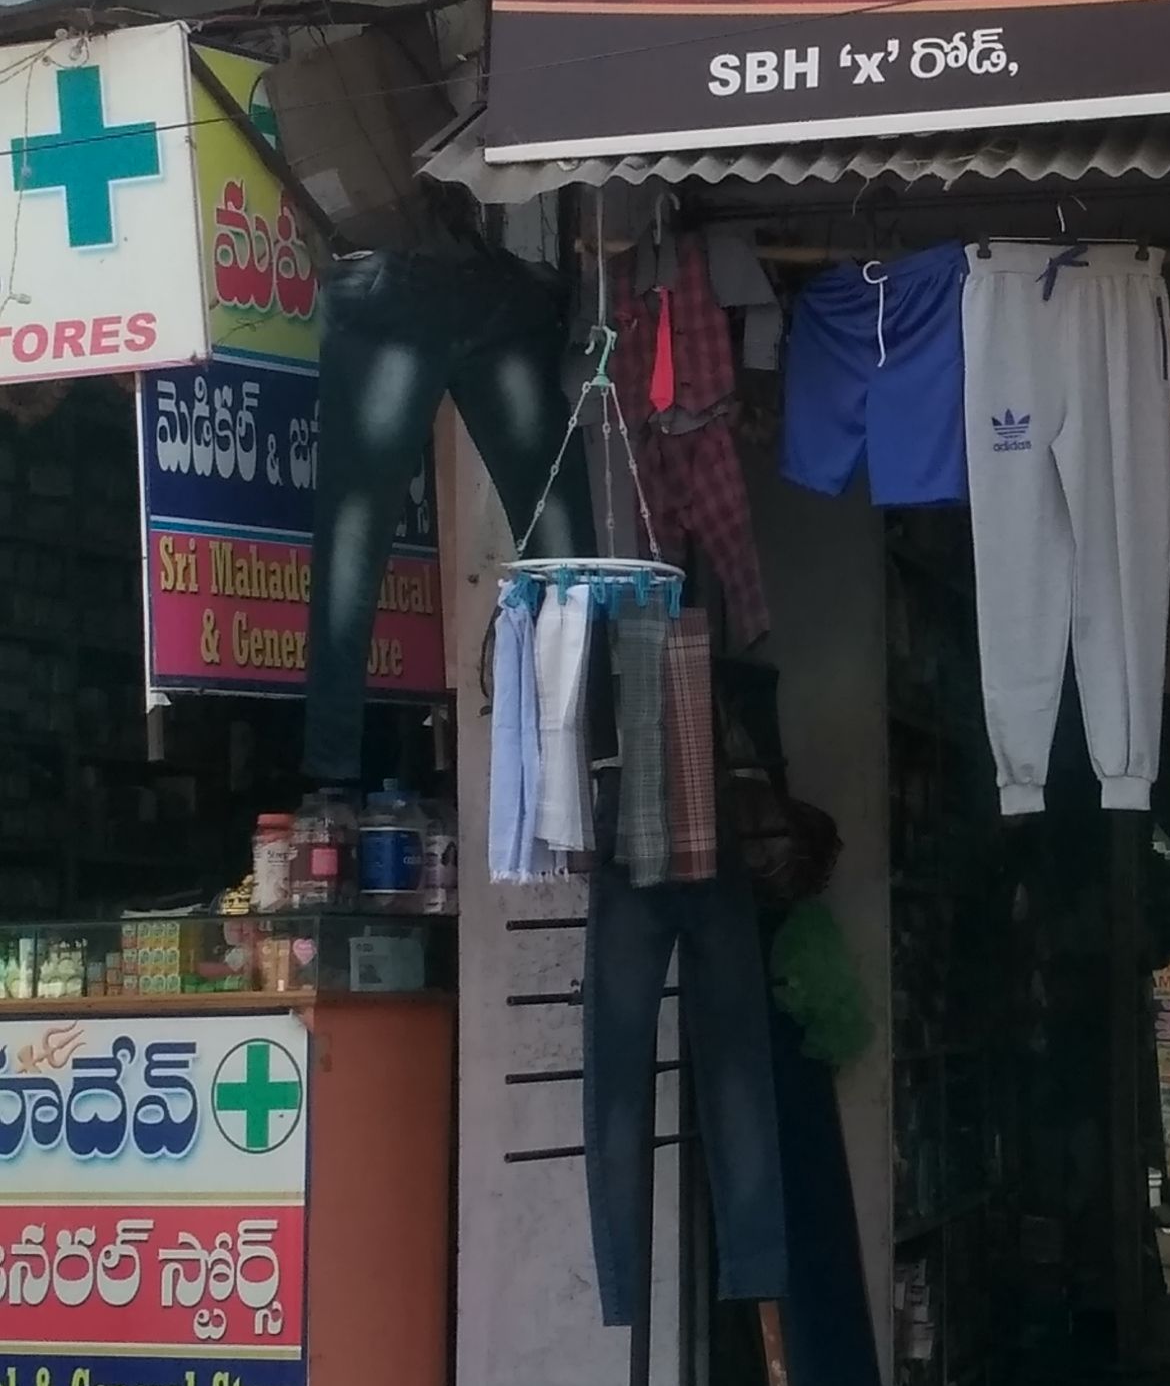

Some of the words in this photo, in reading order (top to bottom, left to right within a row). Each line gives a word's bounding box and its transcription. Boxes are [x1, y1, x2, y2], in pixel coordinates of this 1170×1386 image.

[708, 47, 819, 96] SBH
[266, 433, 283, 486] &
[993, 439, 1031, 452] adidas
[159, 535, 198, 592] Sri
[209, 540, 312, 603] Mahade
[201, 608, 220, 664] &
[232, 610, 306, 669] Gener
